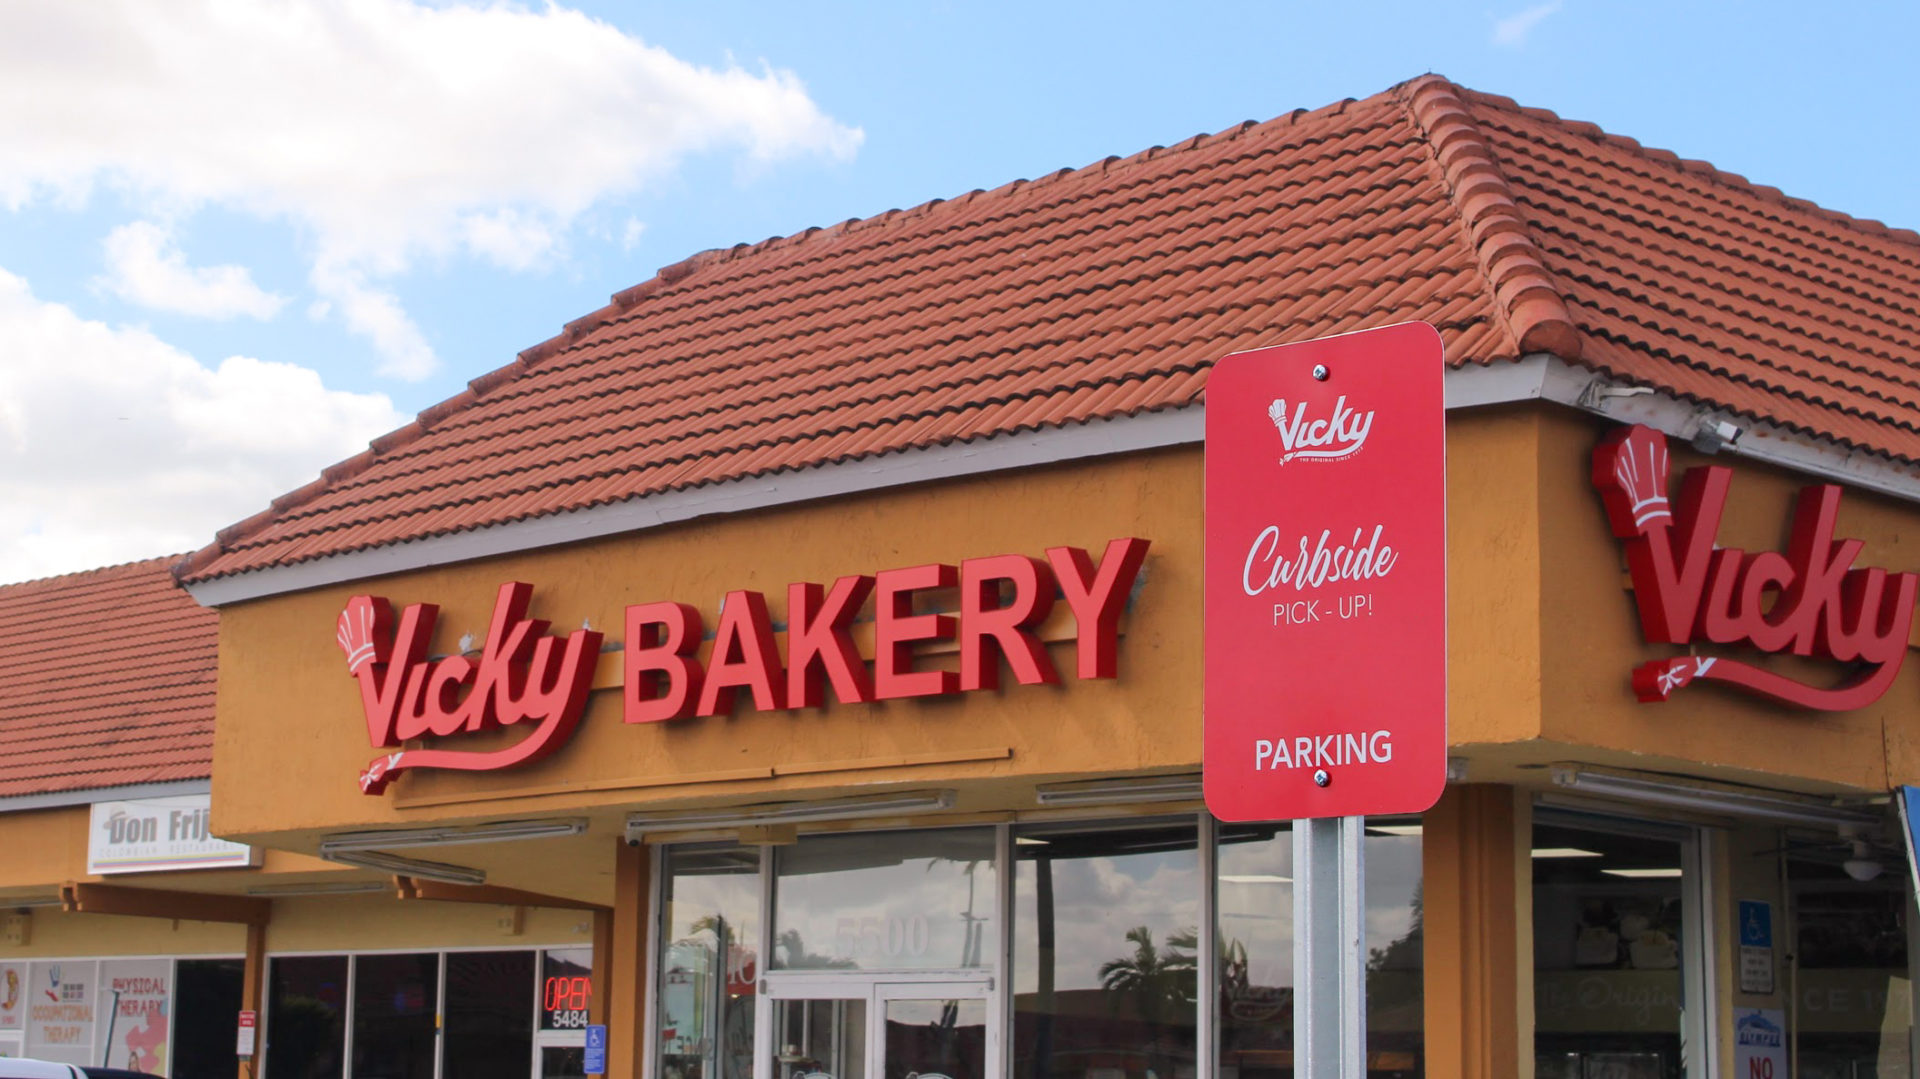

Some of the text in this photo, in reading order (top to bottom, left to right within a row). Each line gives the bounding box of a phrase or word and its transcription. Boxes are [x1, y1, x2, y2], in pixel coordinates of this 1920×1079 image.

[1268, 395, 1375, 466] Vicky
[1243, 525, 1399, 596] Curbside
[1592, 424, 1918, 712] Vicky
[1273, 600, 1320, 626] PICK
[1339, 593, 1373, 620] UP!
[337, 537, 1152, 796] Vicky BAKERY
[1255, 729, 1392, 771] PARKING
[113, 977, 166, 995] PHYSICAL
[43, 1025, 82, 1044] THERAPY
[552, 1009, 588, 1028] 5484
[1749, 1056, 1773, 1079] NO
